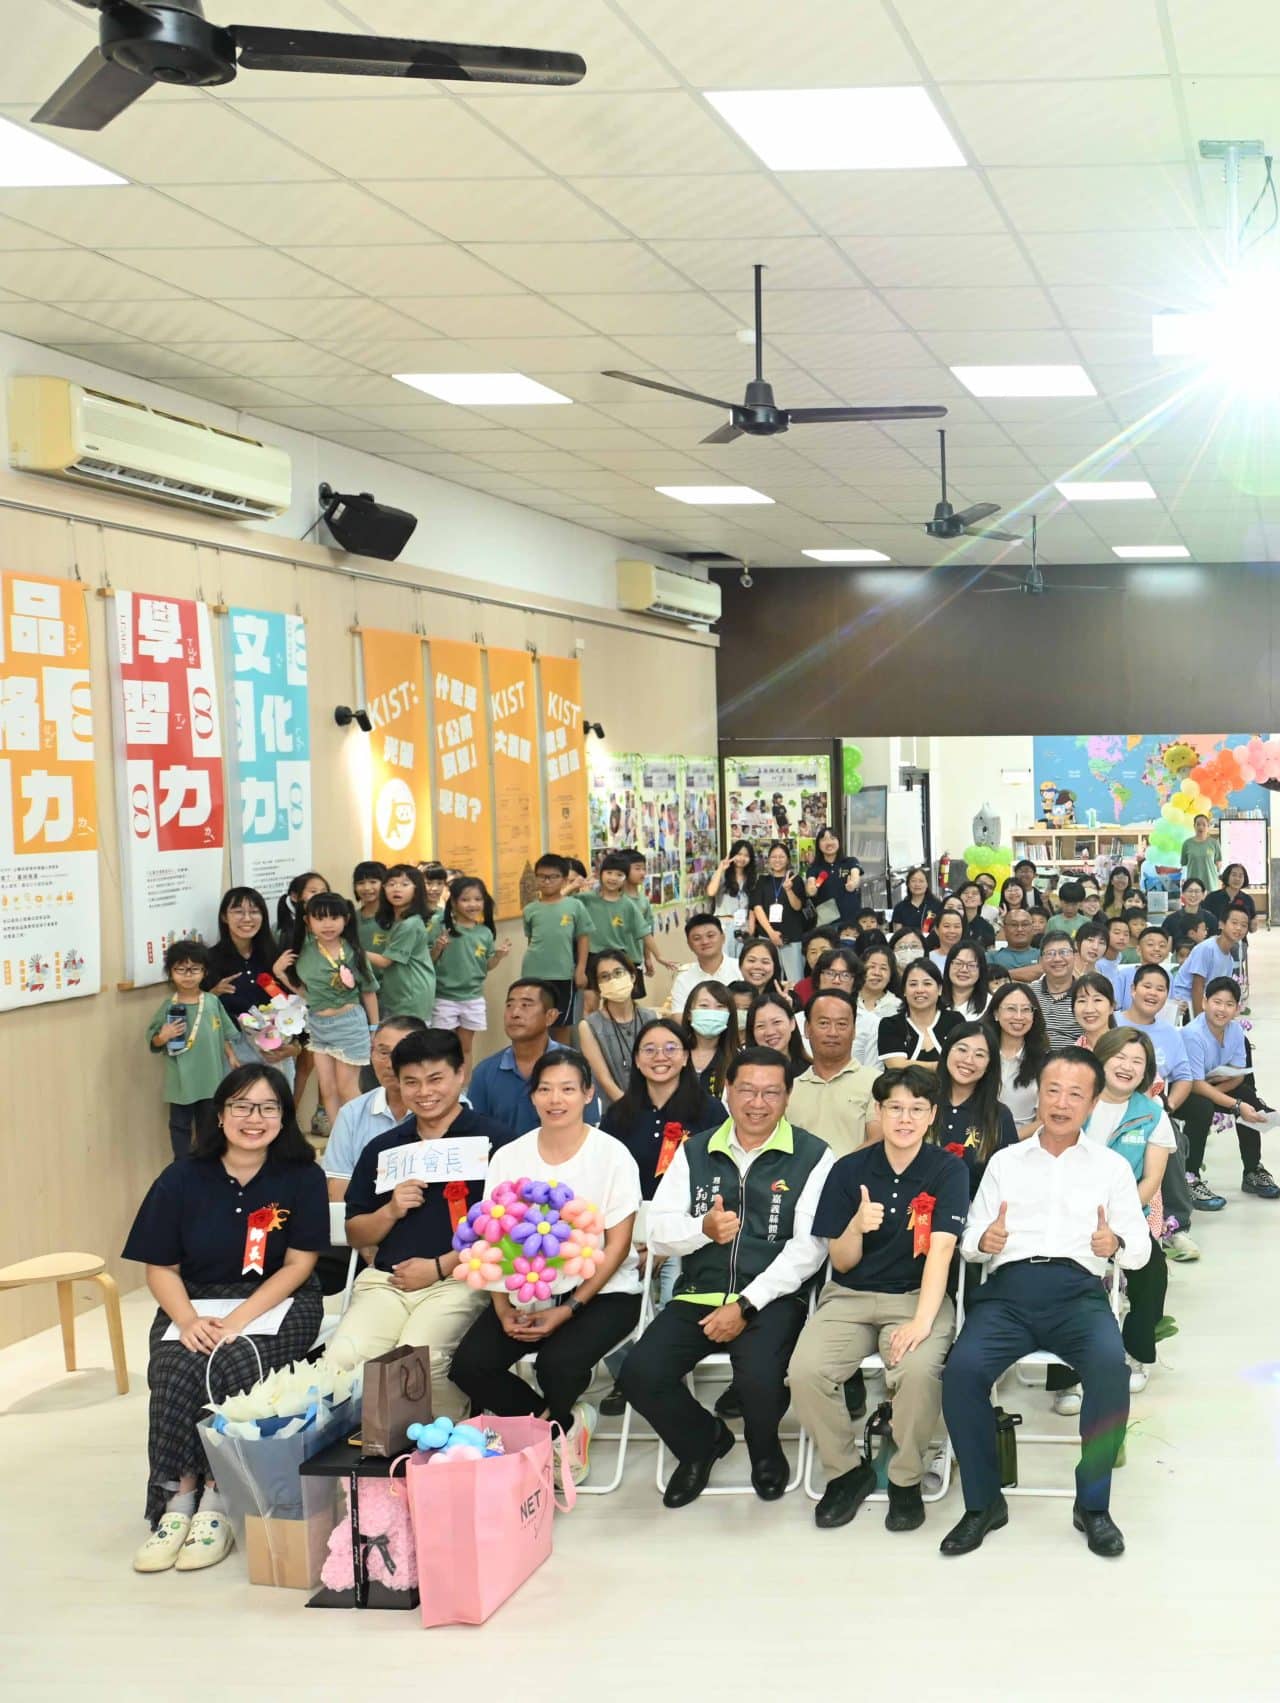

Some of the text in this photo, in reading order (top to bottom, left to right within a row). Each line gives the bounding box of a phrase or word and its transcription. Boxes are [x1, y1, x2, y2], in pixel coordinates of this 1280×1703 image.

[491, 681, 525, 721] KIST
[547, 690, 581, 730] KIST
[519, 1488, 543, 1523] NET
